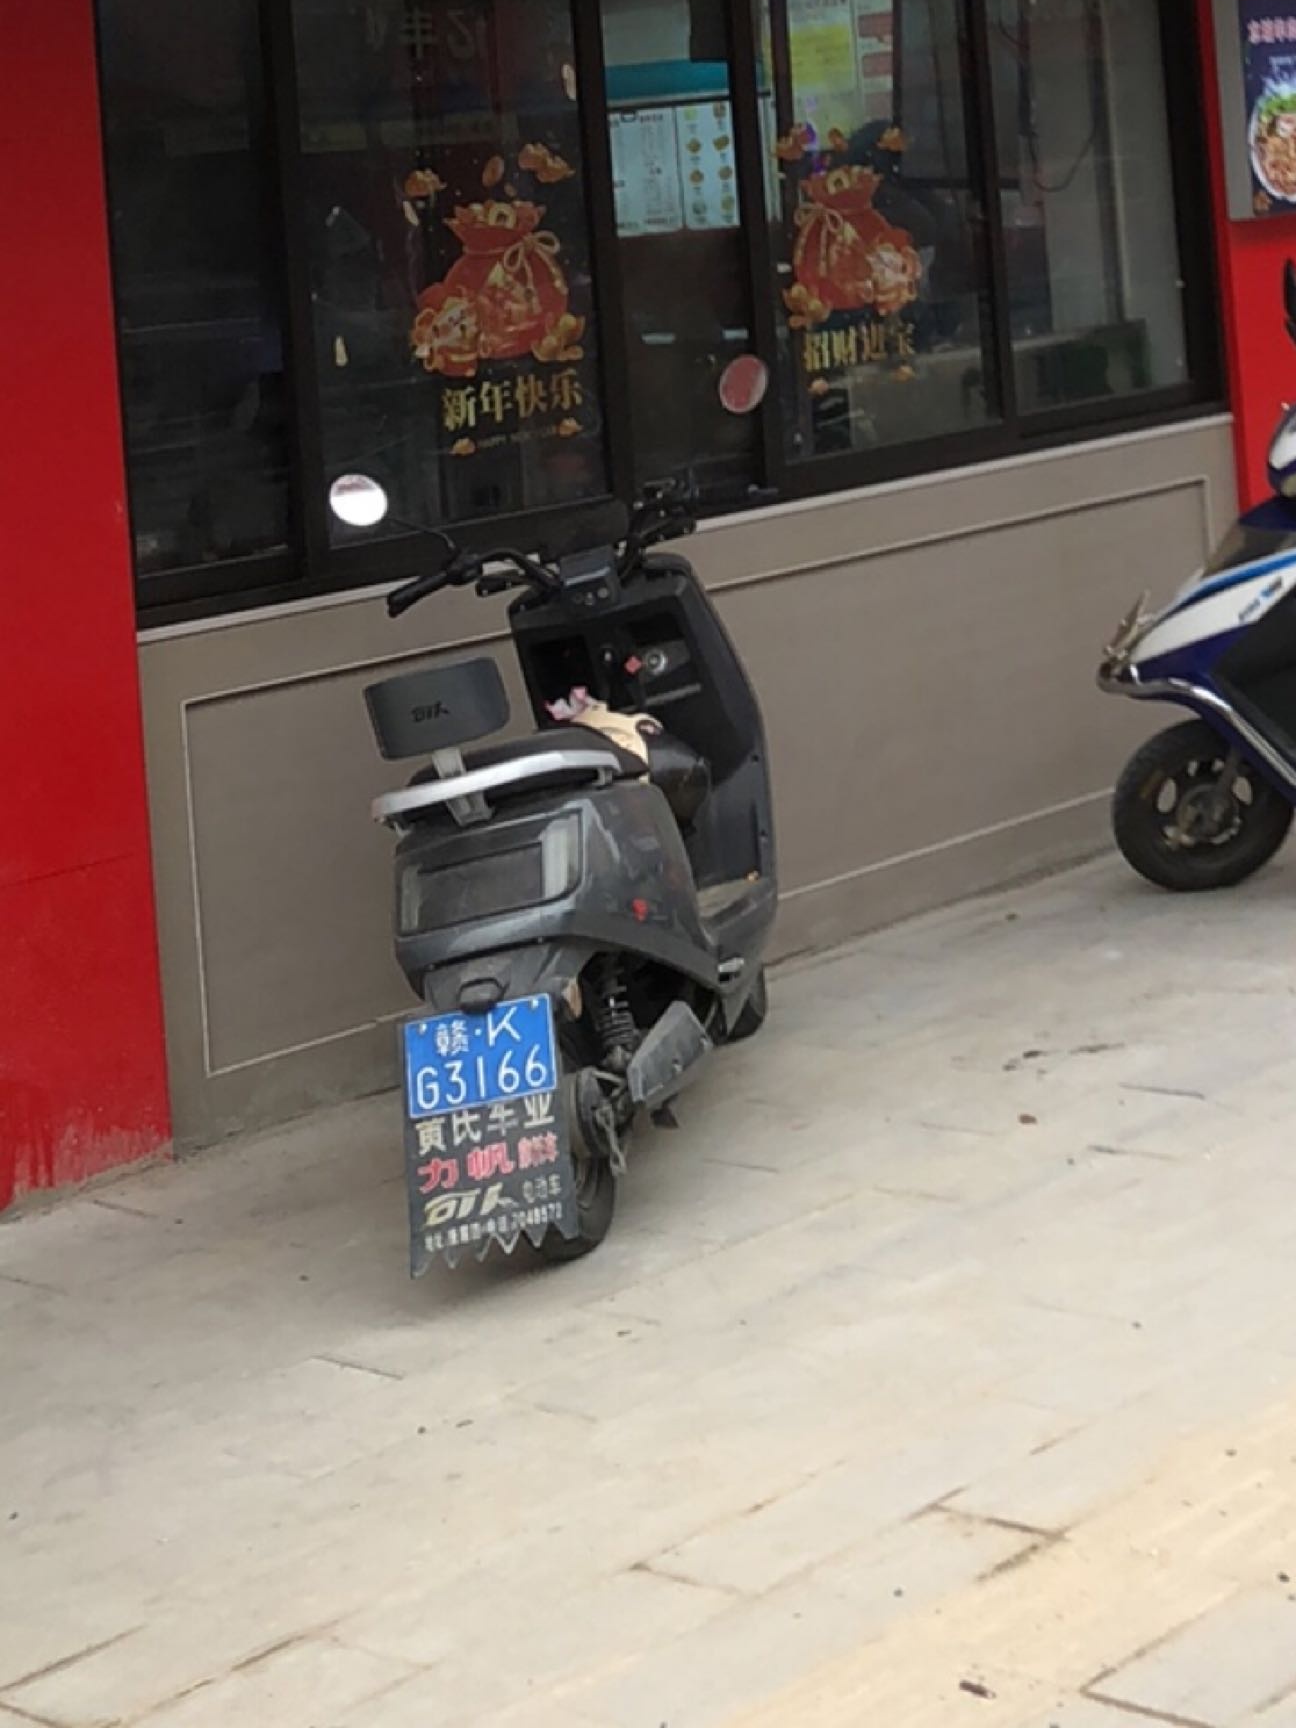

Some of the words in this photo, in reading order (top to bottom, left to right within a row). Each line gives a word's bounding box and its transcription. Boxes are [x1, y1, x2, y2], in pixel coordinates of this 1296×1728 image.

[441, 367, 584, 432] 新年快乐
[415, 1043, 547, 1110] G3166
